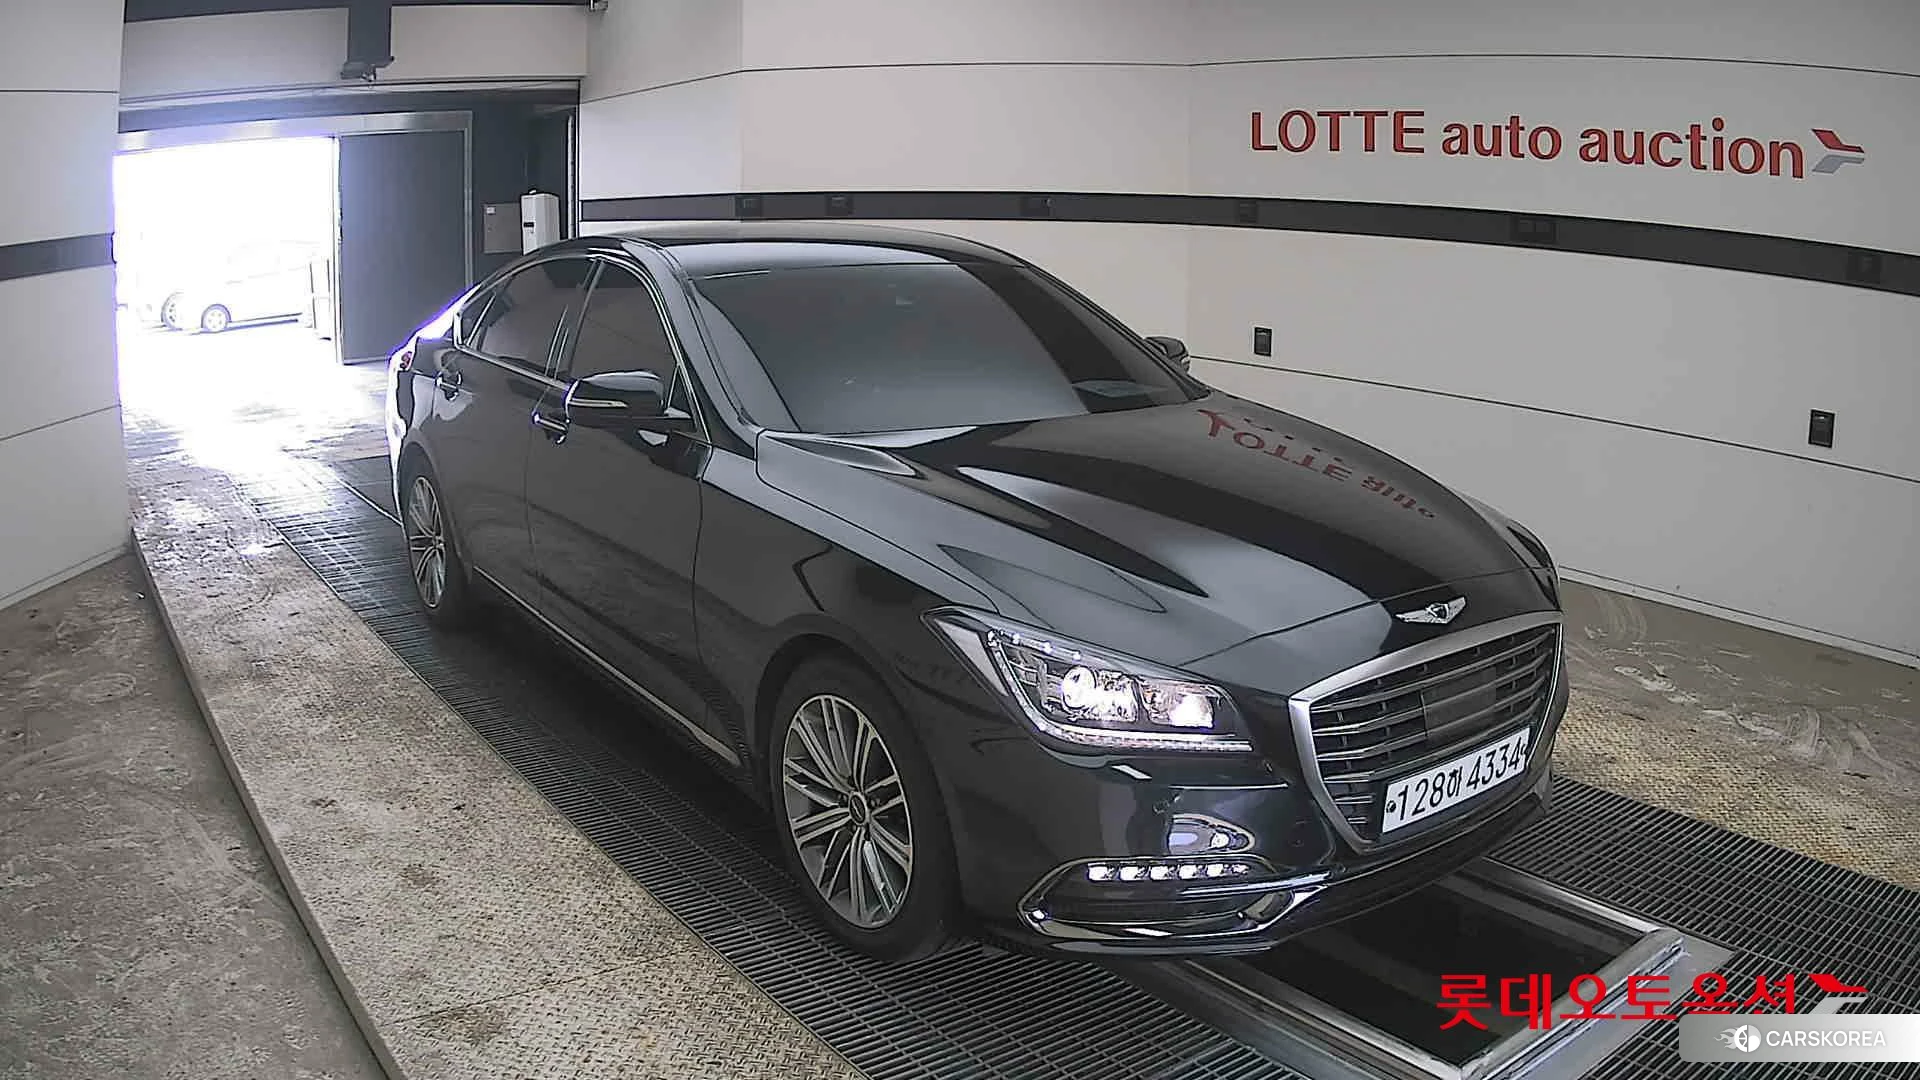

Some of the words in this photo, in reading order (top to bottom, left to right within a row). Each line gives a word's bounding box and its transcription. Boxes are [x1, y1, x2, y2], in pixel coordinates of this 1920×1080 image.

[1251, 110, 1425, 153] LOTTE
[1442, 116, 1562, 160] auto
[1579, 117, 1805, 178] auction
[1467, 736, 1522, 790] 4334
